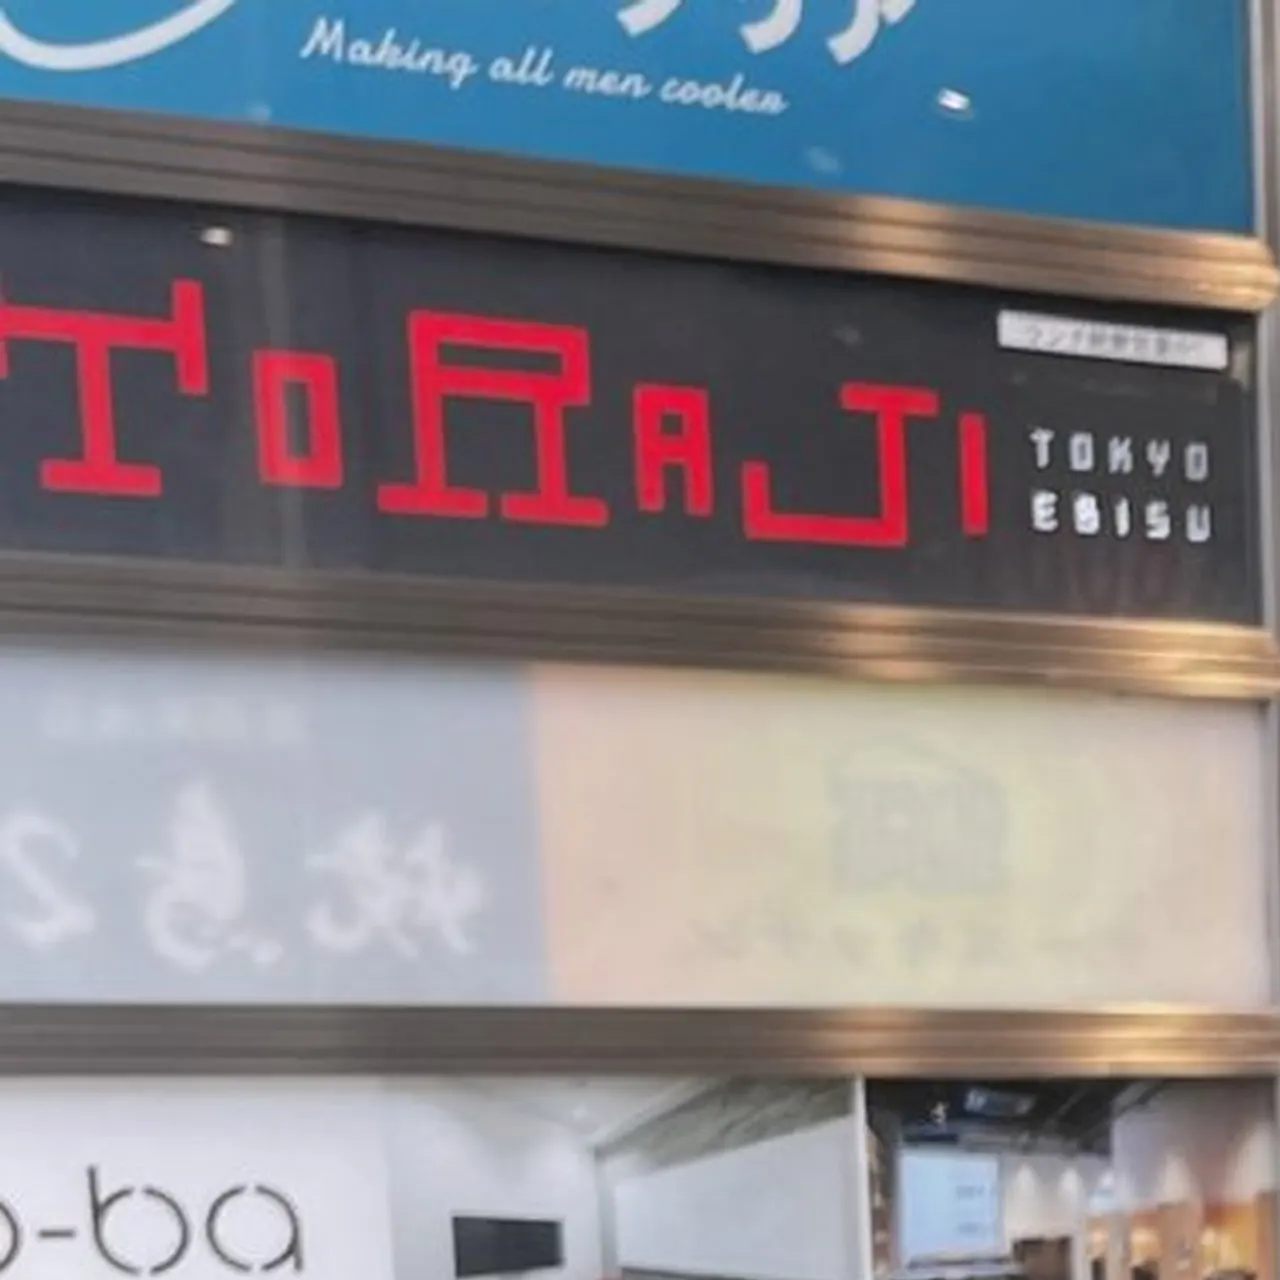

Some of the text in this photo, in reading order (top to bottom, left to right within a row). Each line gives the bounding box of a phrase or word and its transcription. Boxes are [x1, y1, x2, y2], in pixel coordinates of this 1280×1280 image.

[300, 18, 478, 90] Making
[489, 46, 554, 88] all
[562, 62, 652, 98] men
[1029, 427, 1209, 482] TOKYO
[1031, 491, 1211, 543] EBISU
[0, 1163, 304, 1277] -ba
